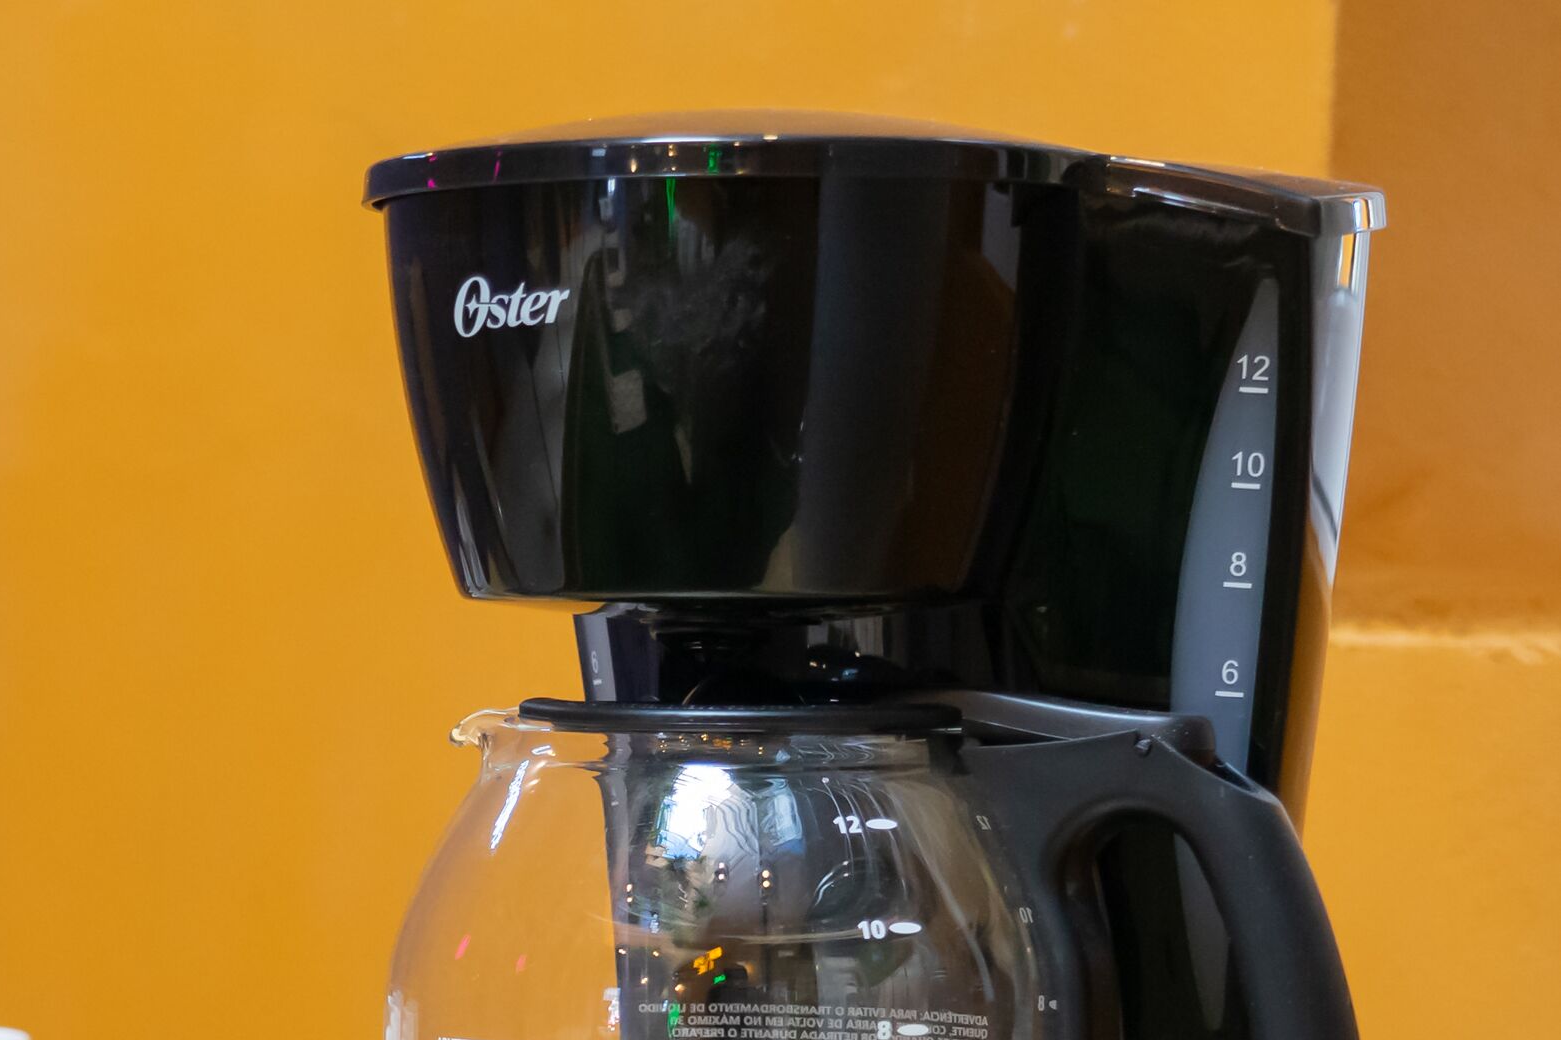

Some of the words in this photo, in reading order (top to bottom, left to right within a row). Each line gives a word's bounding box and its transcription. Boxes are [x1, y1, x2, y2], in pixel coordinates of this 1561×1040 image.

[454, 276, 570, 338] Oster
[1237, 355, 1270, 381] 12
[1232, 452, 1265, 478] 10
[1230, 552, 1246, 576] 8
[1221, 660, 1238, 684] 6
[833, 816, 862, 834] 12
[858, 920, 885, 940] 10
[878, 1020, 892, 1040] 8
